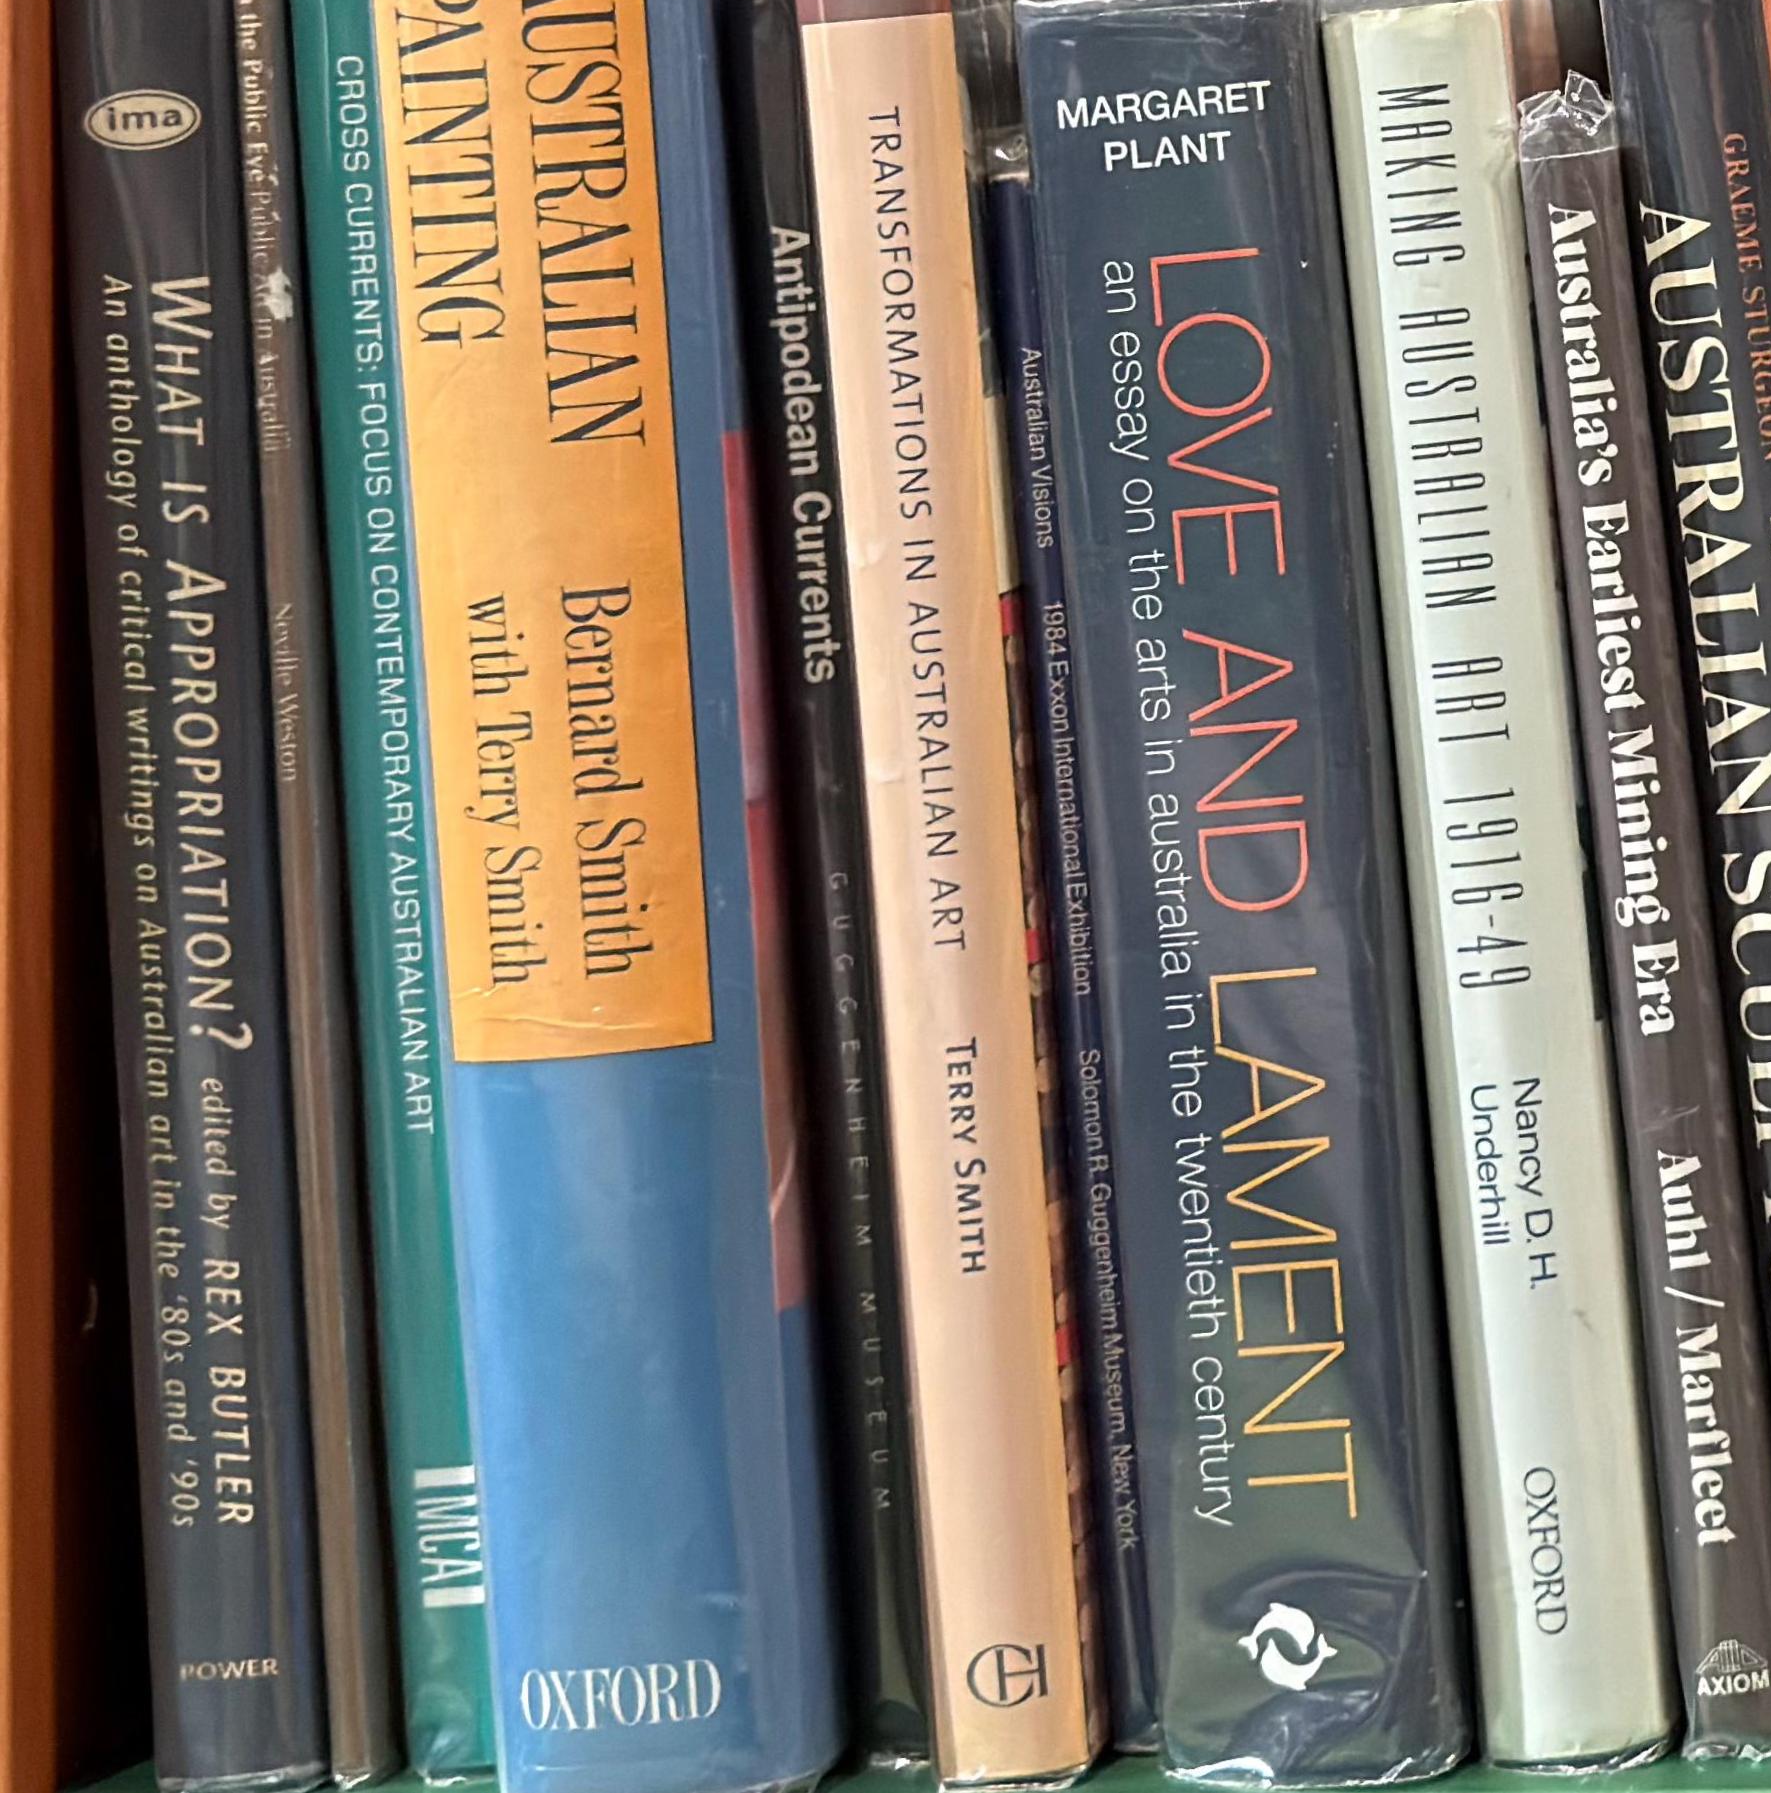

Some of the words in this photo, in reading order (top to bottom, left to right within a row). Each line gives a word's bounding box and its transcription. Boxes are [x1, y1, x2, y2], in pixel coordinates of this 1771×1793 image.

[105, 104, 185, 131] ima
[334, 54, 371, 172] CROSS
[1056, 81, 1274, 129] MARGARET
[1103, 132, 1234, 172] PLANT
[1377, 82, 1466, 269] MAKING
[1720, 130, 1763, 273] GRAEME
[343, 182, 385, 374] CURRENTS:
[865, 104, 932, 519] TRANSFORMATIONS
[96, 330, 146, 508] anthology
[148, 274, 218, 447] WHAT
[762, 222, 829, 478] Antipodean
[1098, 330, 1150, 464] essay
[1146, 246, 1289, 584] LOVE
[161, 478, 210, 525] IS
[357, 382, 394, 496] FOCUS
[1397, 305, 1498, 610] AUSTRALIAN
[365, 507, 397, 554] ON
[789, 489, 844, 685] Currents
[901, 538, 938, 582] IN
[1127, 551, 1170, 622] the
[116, 569, 155, 692] critical
[464, 592, 529, 696] with
[1580, 500, 1653, 714] Earliest
[368, 564, 415, 843] CONTEMPORARY
[557, 579, 643, 798] Bernard
[906, 600, 960, 858] AUSTRALIAN
[1044, 659, 1073, 733] Exxon
[1132, 636, 1177, 723] arts
[1429, 655, 1510, 748] ART
[124, 705, 163, 847] writings
[164, 557, 252, 1051] APPROPRIATION?
[456, 710, 539, 833] Terry
[1050, 737, 1087, 878] International
[1178, 621, 1313, 916] AND
[1605, 725, 1674, 928] Mining
[479, 842, 549, 986] Smith
[571, 816, 657, 979] Smith
[927, 876, 967, 953] ART
[1062, 883, 1095, 996] Exhibition
[1146, 790, 1201, 978] australia
[1441, 788, 1533, 991] 1916-49
[136, 918, 178, 1098] Australian
[387, 850, 431, 1061] AUSTRALIAN
[1630, 939, 1685, 1036] Era
[198, 1076, 234, 1176] edited
[402, 1071, 435, 1135] ART
[943, 1036, 984, 1145] TERRY
[1167, 1046, 1213, 1117] the
[1507, 1076, 1552, 1199] Nancy
[197, 1191, 237, 1230] by
[952, 1156, 994, 1274] SMITH
[1467, 1082, 1512, 1246] Underhill
[1656, 1145, 1712, 1272] Auhl
[202, 1256, 243, 1337] REX
[1172, 1132, 1230, 1341] twentieth
[1203, 965, 1364, 1528] LAMENT
[209, 1364, 255, 1526] BUTLER
[1182, 1354, 1239, 1529] century
[1674, 1324, 1743, 1547] Marfleet
[1521, 1465, 1571, 1637] OXFORD
[178, 1657, 279, 1681] POWER
[517, 1656, 725, 1735] OXFORD
[1696, 1669, 1771, 1697] AXIOM
